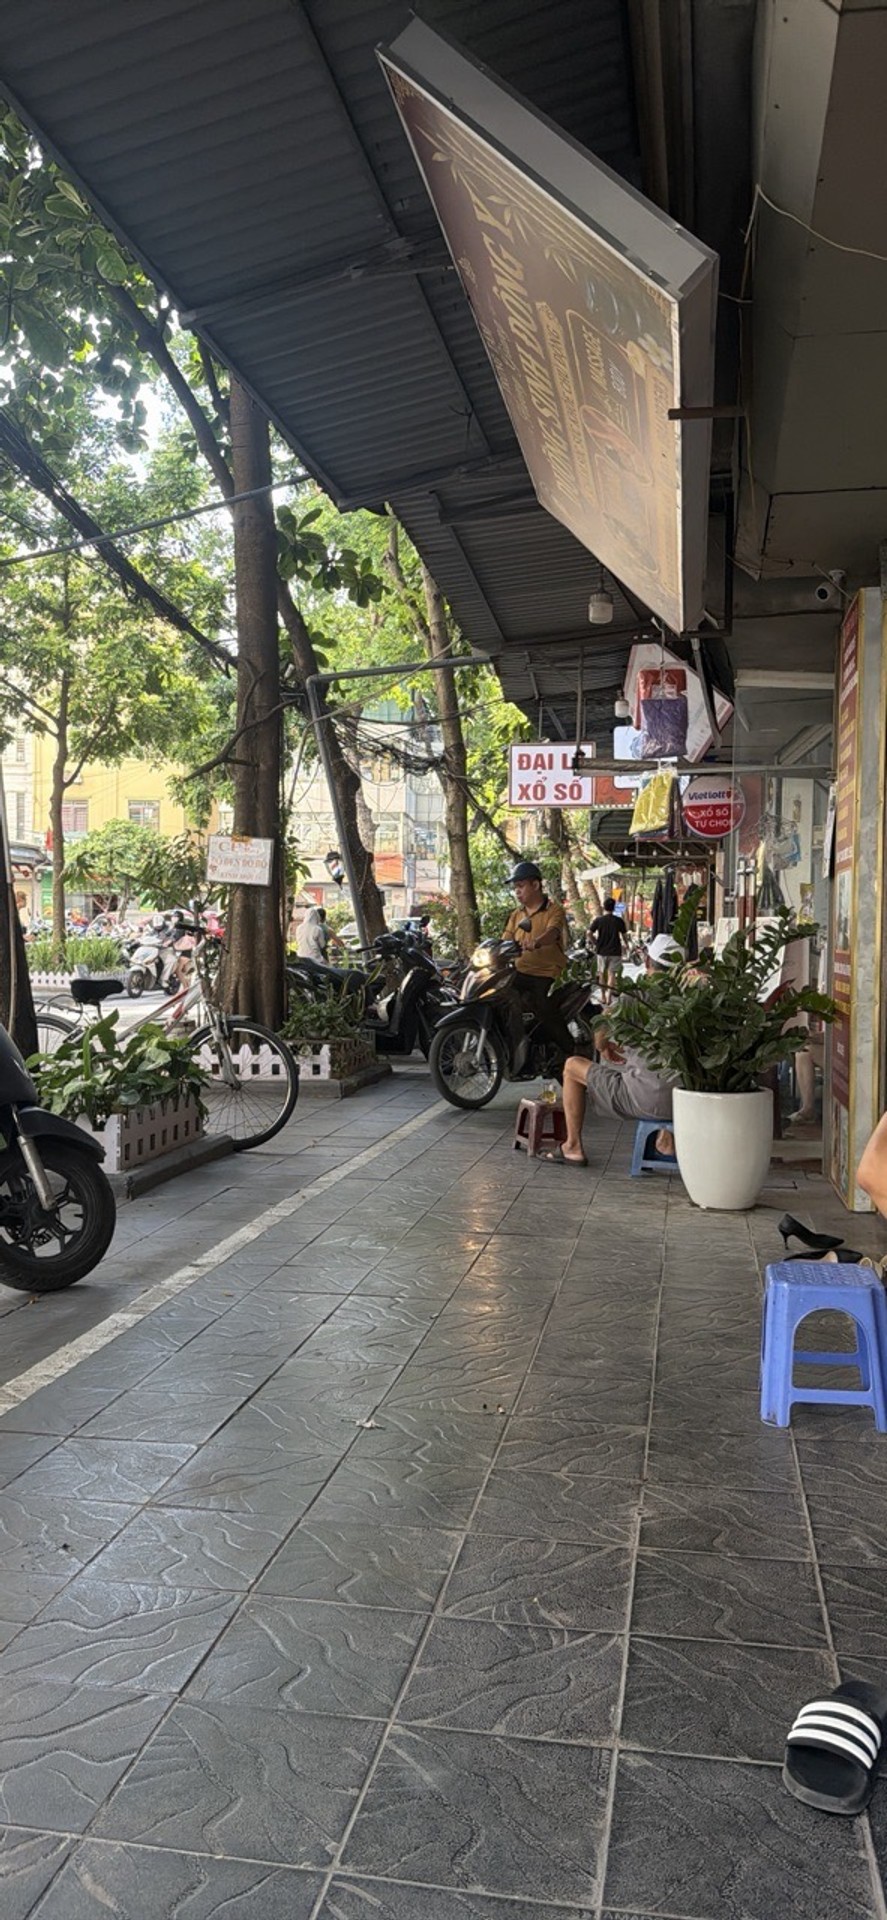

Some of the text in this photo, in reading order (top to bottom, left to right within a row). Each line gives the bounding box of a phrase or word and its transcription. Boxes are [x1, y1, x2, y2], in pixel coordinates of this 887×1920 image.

[468, 185, 515, 244] Y
[481, 229, 544, 359] ĐÔNG
[581, 323, 608, 392] MASSAGE
[608, 358, 628, 400] BODY
[515, 342, 562, 432] SINH
[517, 753, 553, 775] ĐẠI
[517, 776, 546, 801] XỔ
[688, 791, 726, 800] Vietlott
